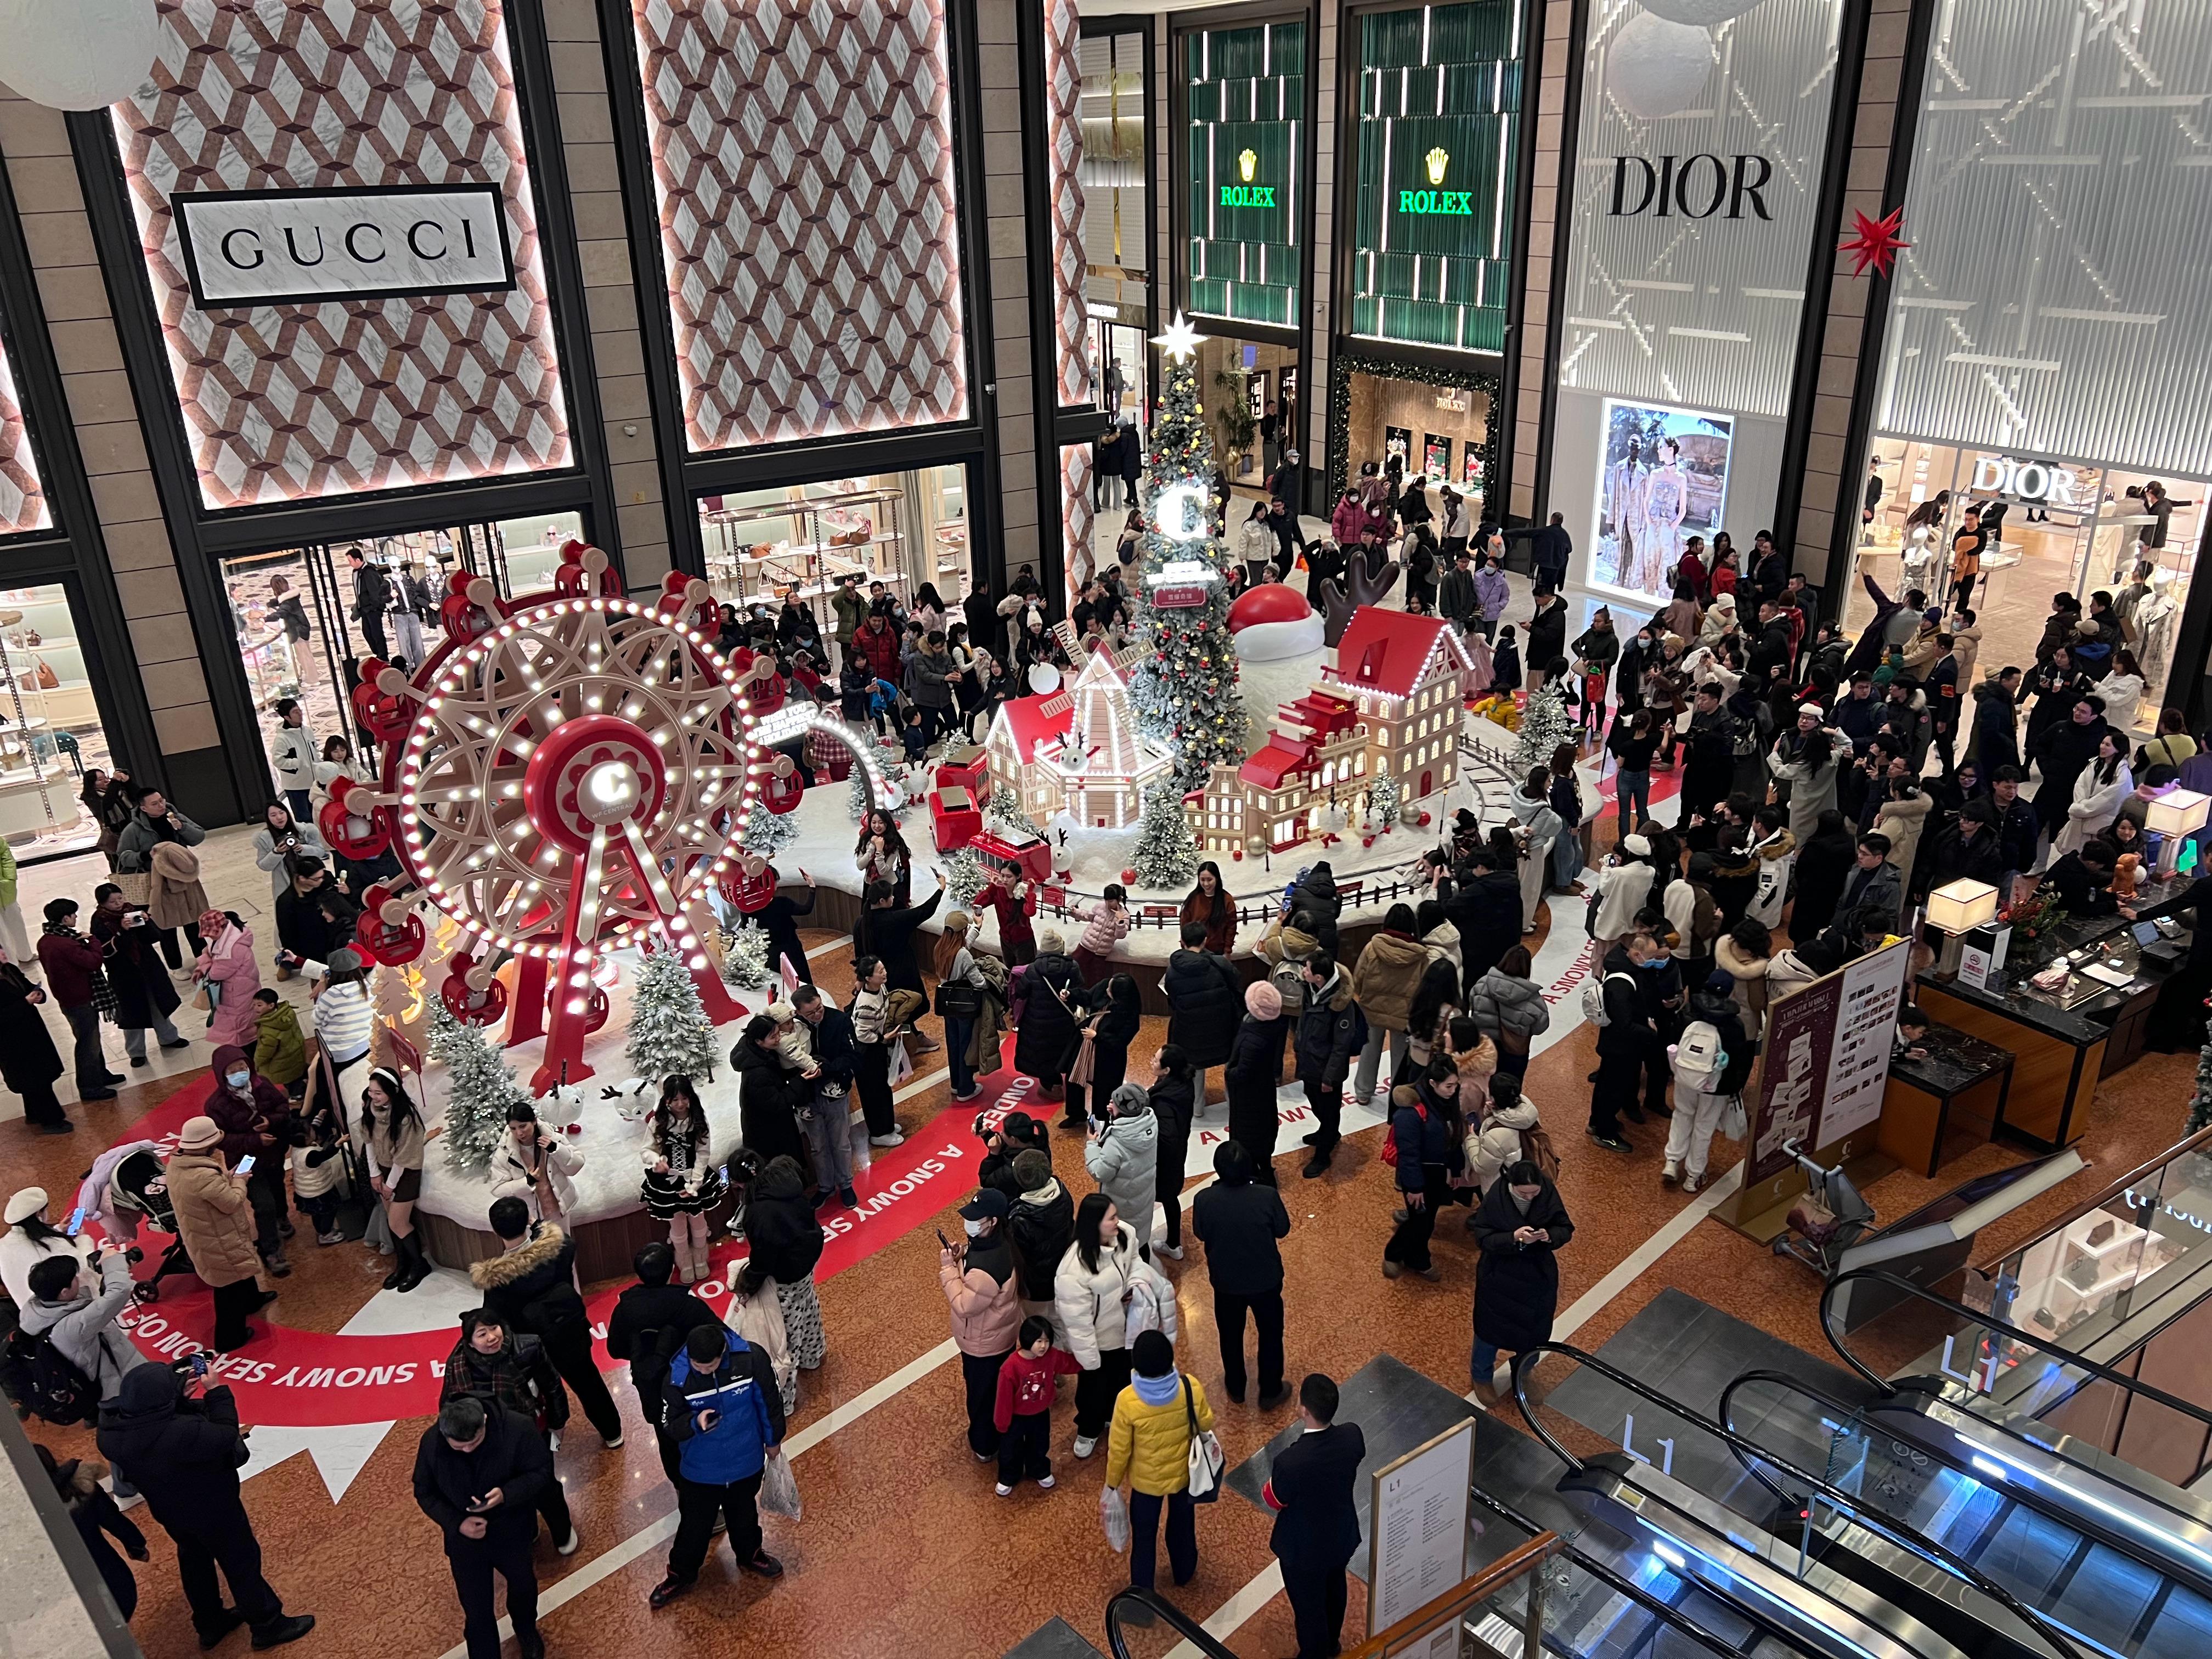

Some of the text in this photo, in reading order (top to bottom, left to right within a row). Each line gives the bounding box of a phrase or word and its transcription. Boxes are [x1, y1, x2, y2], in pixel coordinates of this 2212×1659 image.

[1221, 186, 1276, 207] ROLEX
[1399, 190, 1472, 215] ROLEX
[1606, 154, 1774, 221] DIOR
[221, 218, 477, 270] GUCCI
[1971, 456, 2077, 505] DIOR
[786, 702, 806, 717] YOU
[603, 803, 634, 815] CENTRAL
[1541, 953, 1592, 1005] A SNOWY
[1200, 1131, 1221, 1146] A
[852, 1143, 964, 1222] A SNOWY
[153, 1331, 276, 1383] SEAON
[273, 1363, 417, 1387] SNOWY
[1940, 1335, 1998, 1392] L1
[1622, 1414, 1674, 1476] L1
[1390, 1479, 1400, 1492] L1
